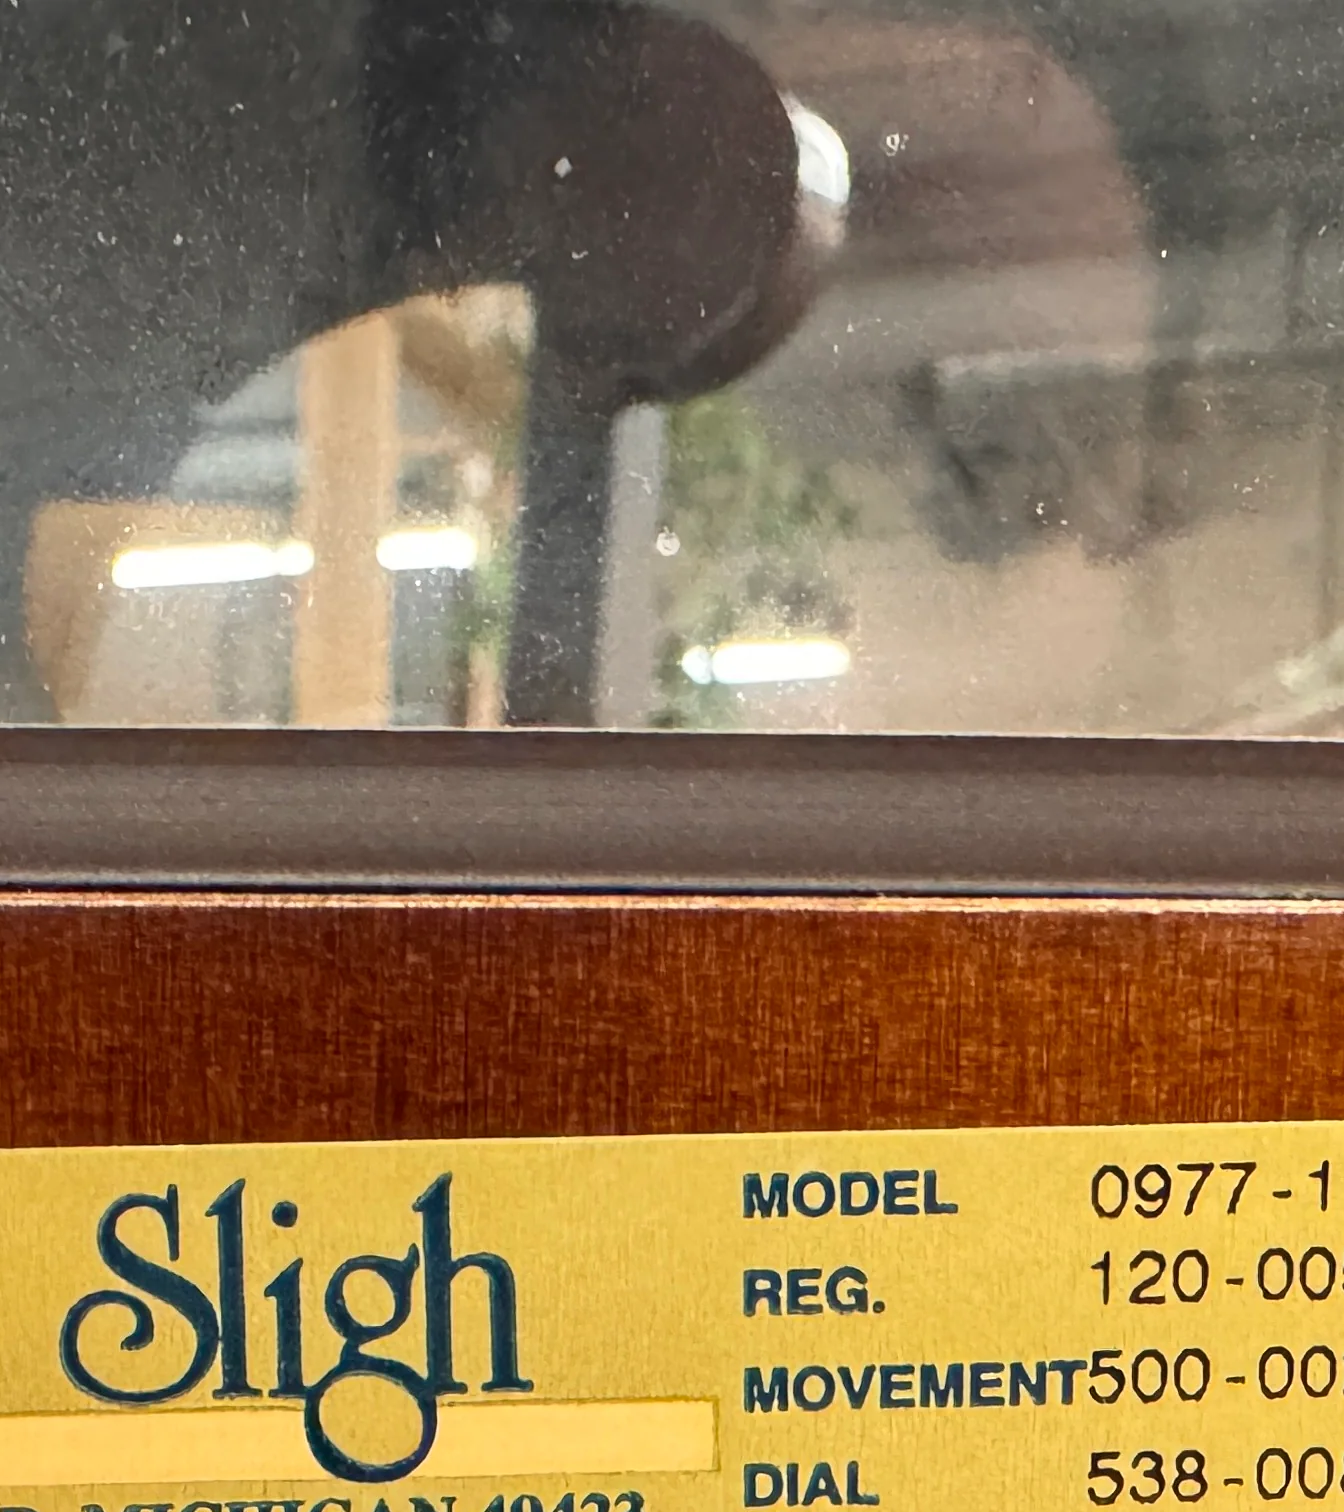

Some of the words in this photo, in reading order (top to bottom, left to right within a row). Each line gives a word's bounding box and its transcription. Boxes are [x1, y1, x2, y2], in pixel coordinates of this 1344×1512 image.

[743, 1169, 959, 1219] MODEL
[743, 1265, 886, 1318] REG.
[58, 1173, 534, 1484] Sligh
[743, 1359, 1088, 1414] MOVEMENT
[743, 1460, 880, 1508] DIAL
